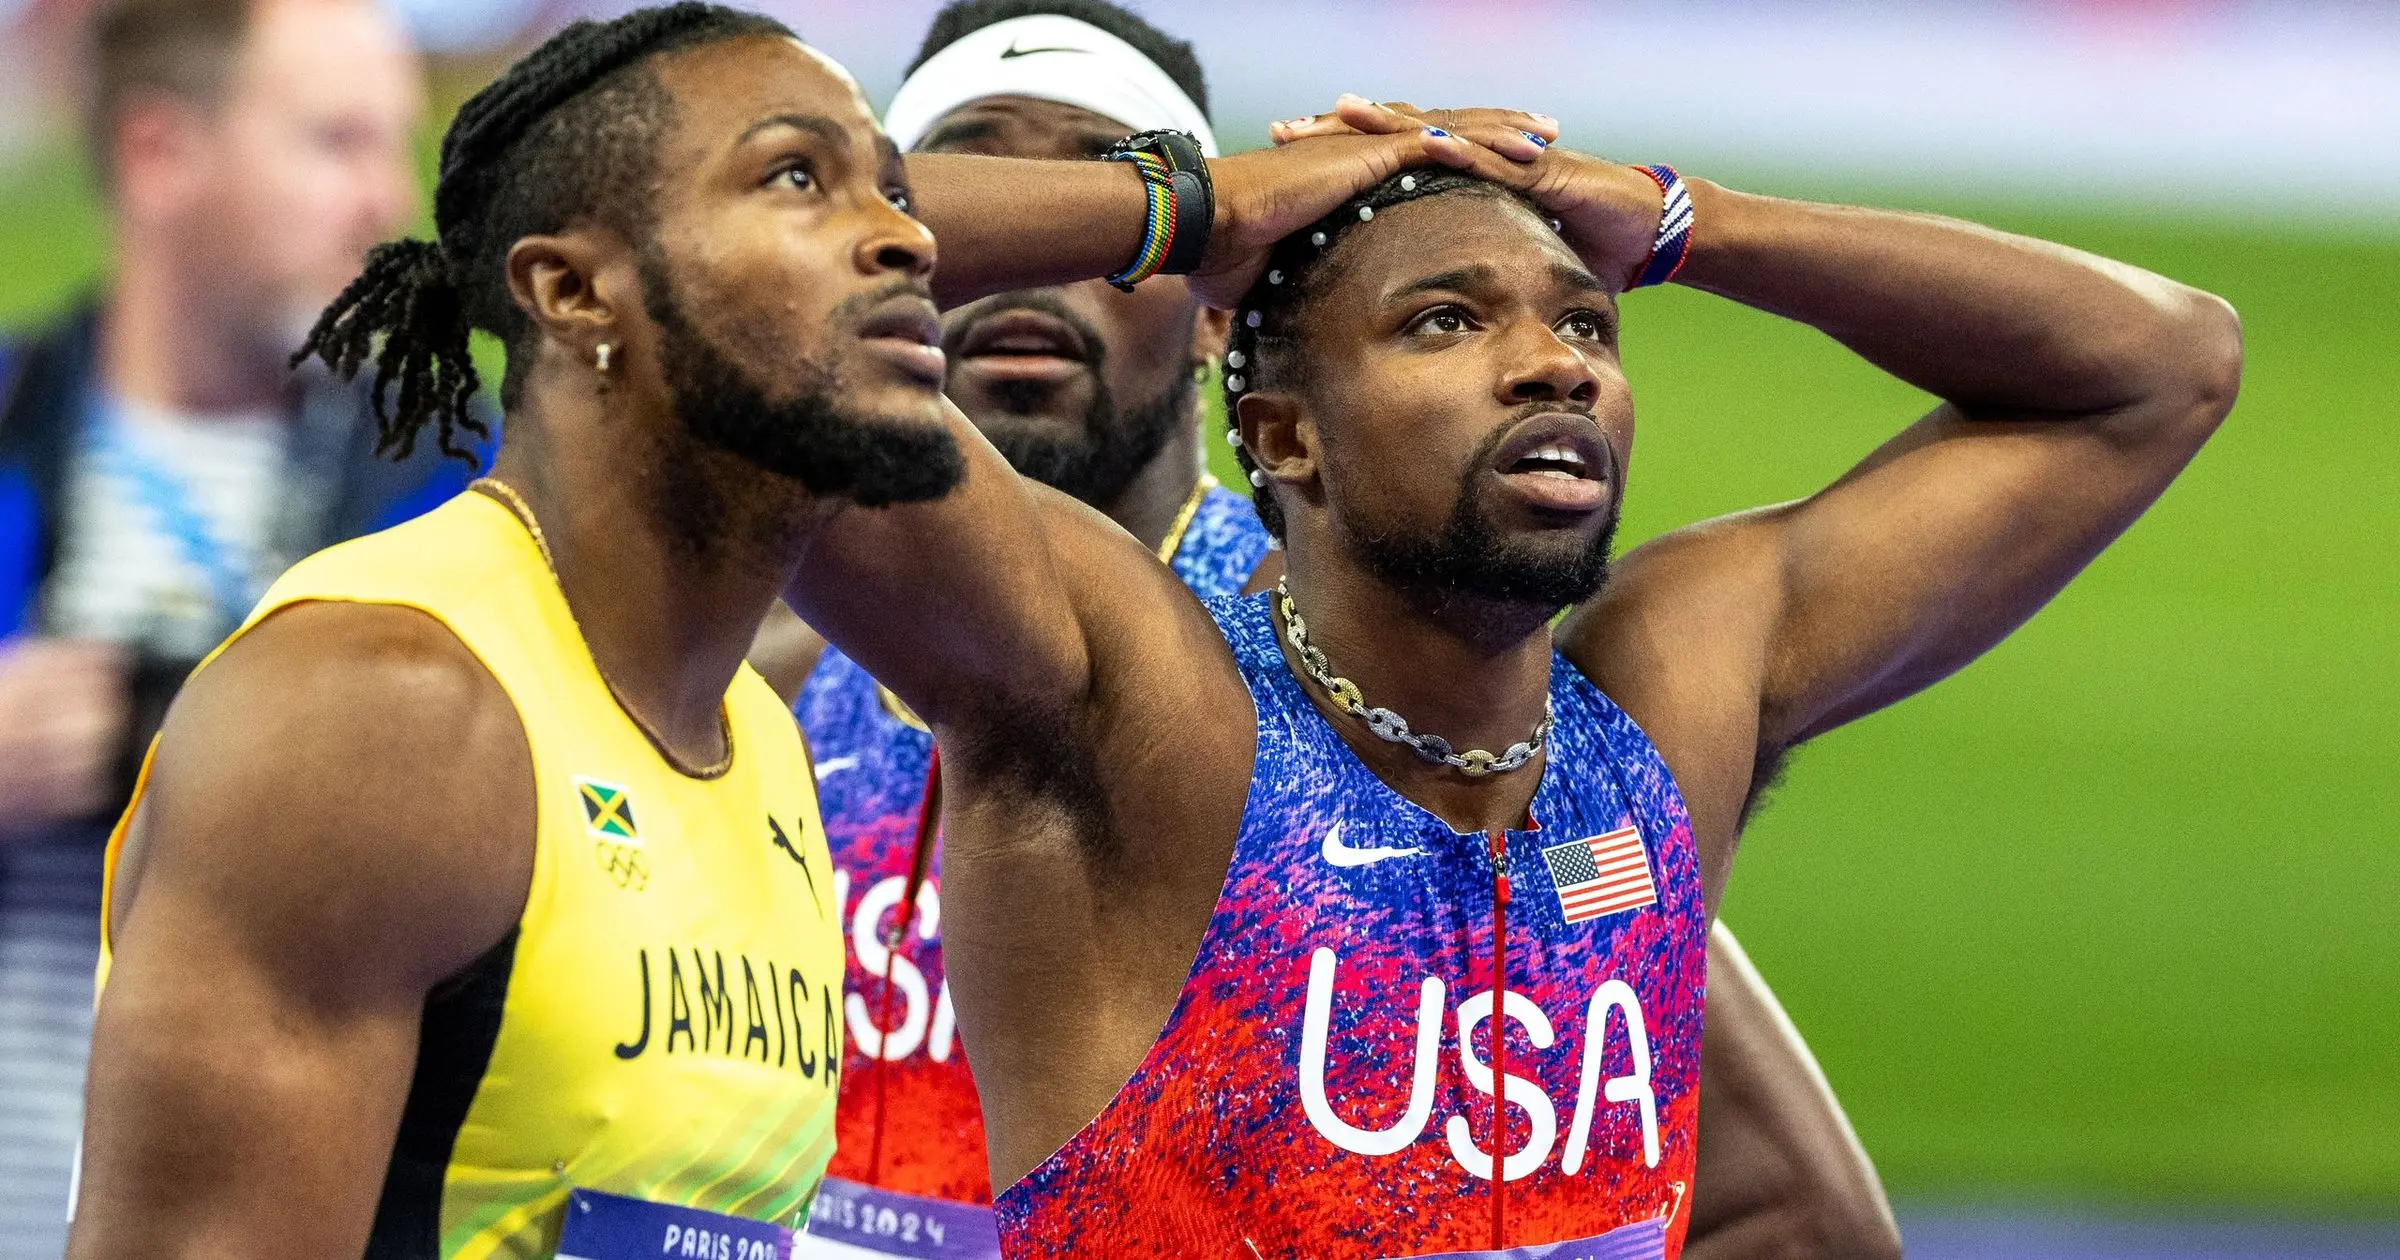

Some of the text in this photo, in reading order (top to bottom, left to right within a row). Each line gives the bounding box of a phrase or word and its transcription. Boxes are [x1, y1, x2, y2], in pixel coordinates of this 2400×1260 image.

[614, 947, 838, 1089] JAMAICA
[1300, 946, 1659, 1181] USA
[662, 1224, 731, 1260] PARIS
[860, 1203, 946, 1247] 2024
